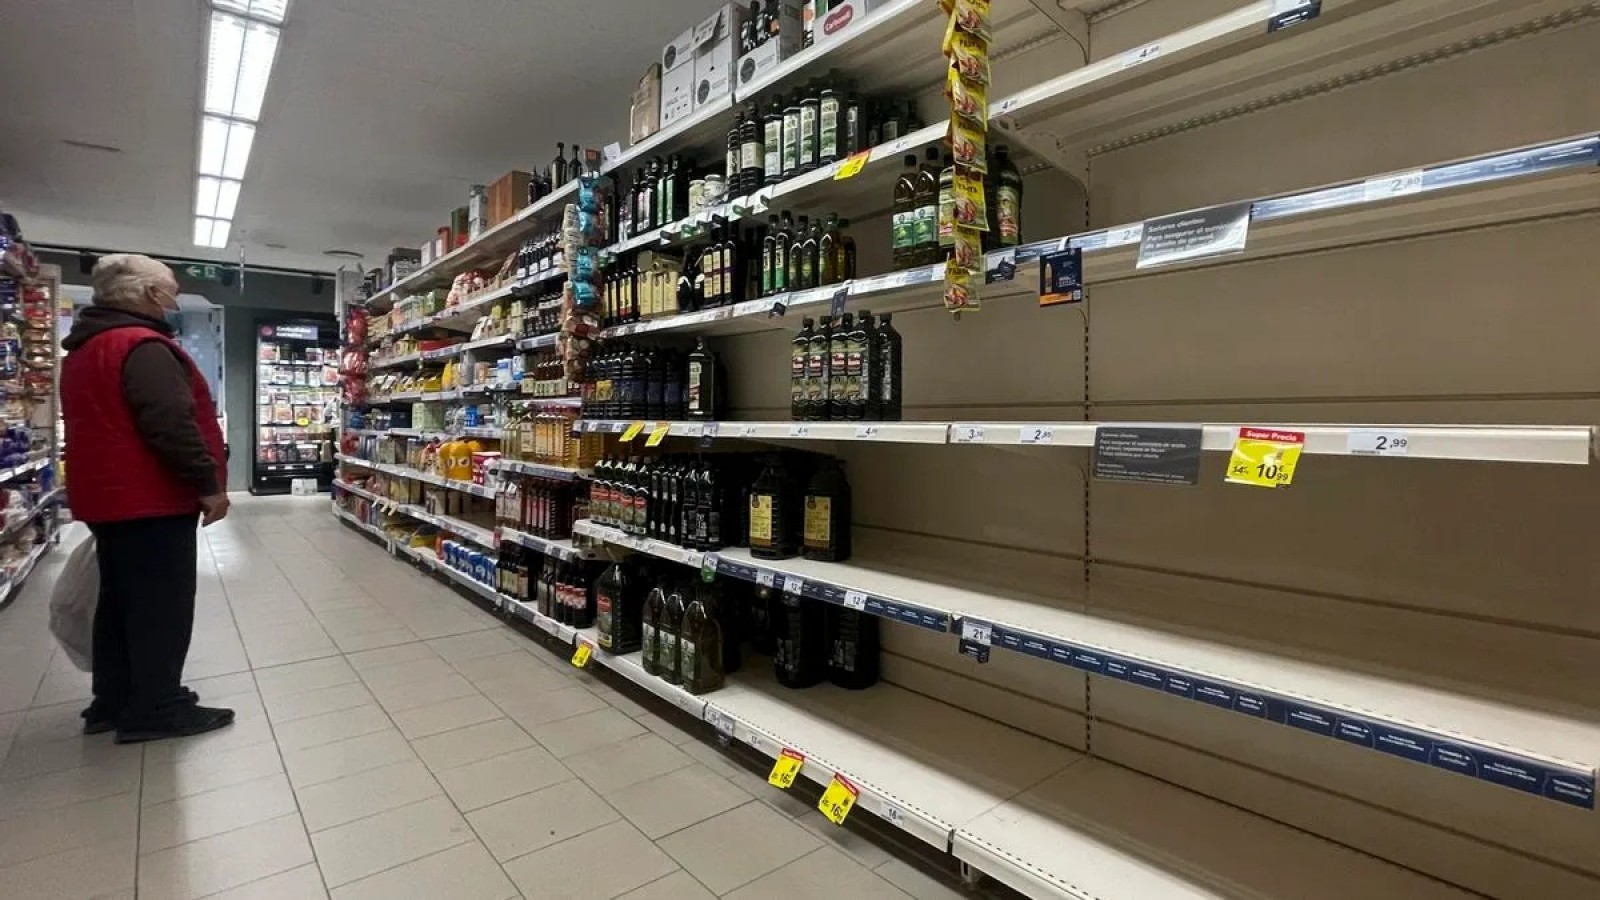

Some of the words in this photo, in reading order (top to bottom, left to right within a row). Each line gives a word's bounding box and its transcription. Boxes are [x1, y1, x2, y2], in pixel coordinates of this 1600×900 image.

[1246, 430, 1270, 441] Super
[1271, 432, 1297, 442] Precio
[1376, 436, 1408, 450] 2,99
